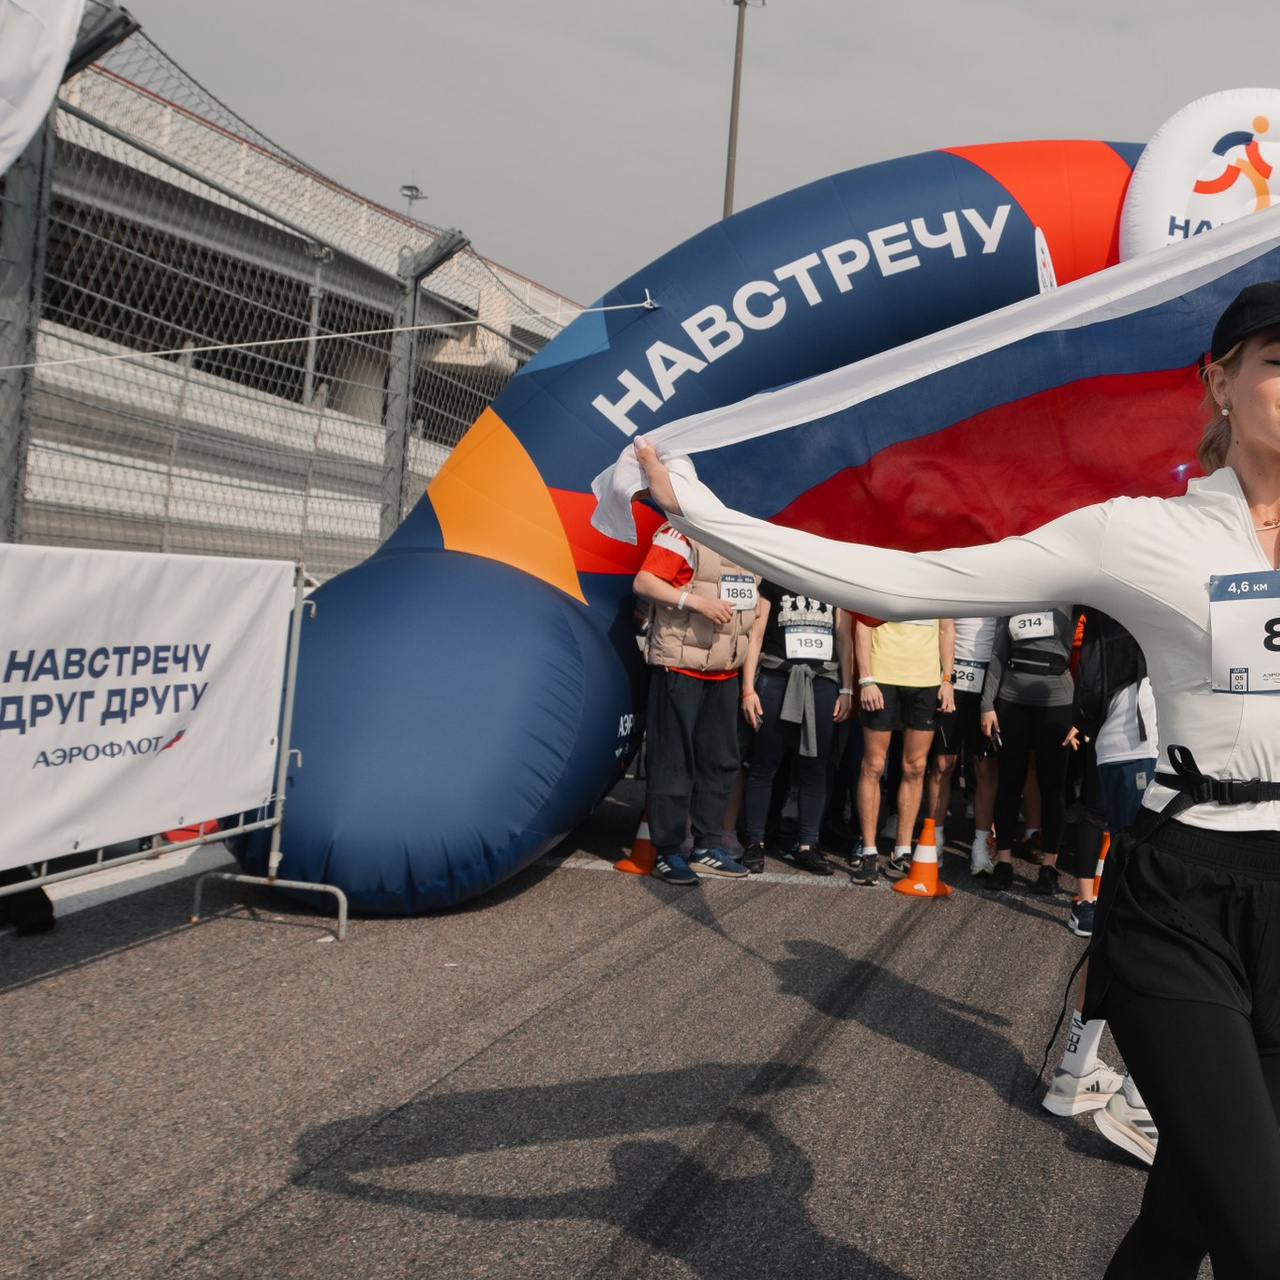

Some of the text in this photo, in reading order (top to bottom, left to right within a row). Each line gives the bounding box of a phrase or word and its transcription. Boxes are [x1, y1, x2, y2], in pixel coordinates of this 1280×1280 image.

[591, 204, 1012, 437] НАВСТРЕЧУ
[725, 588, 753, 599] 1863
[1227, 581, 1250, 593] 4,6
[1018, 617, 1042, 629] 314
[796, 638, 823, 649] 189
[2, 643, 211, 683] НАВСТРЕЧУ
[0, 682, 208, 735] ДРУГ ДРУГУ
[32, 735, 163, 770] АЭРОФЛОТ
